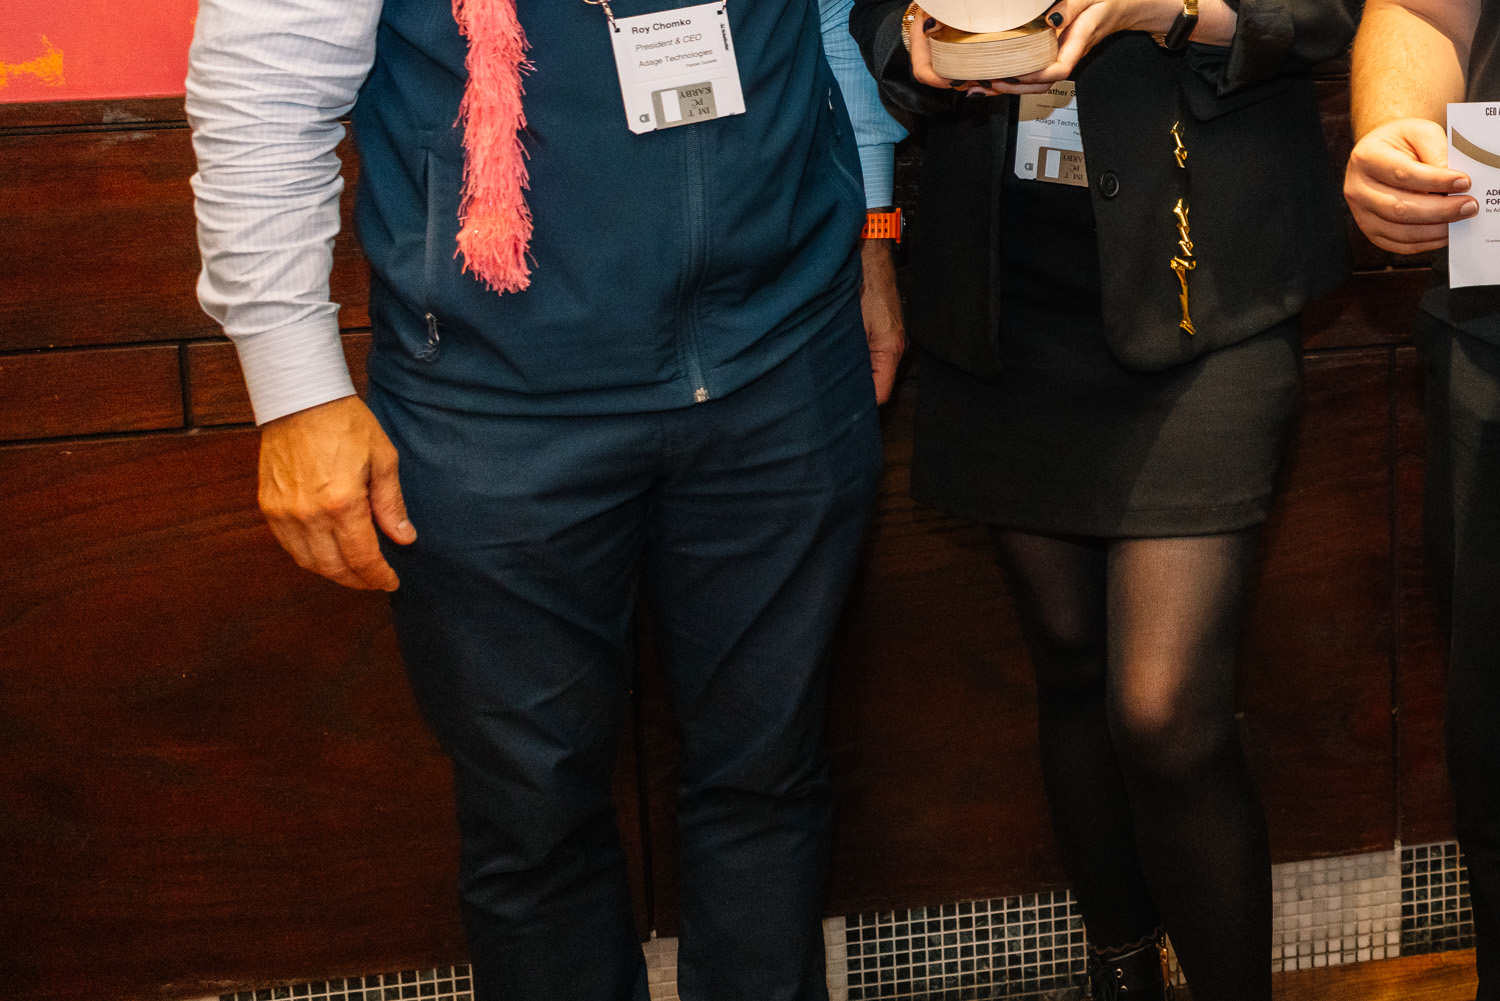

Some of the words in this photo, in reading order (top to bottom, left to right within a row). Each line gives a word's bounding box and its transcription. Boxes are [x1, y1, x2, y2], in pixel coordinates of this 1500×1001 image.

[631, 25, 650, 35] Roy
[652, 18, 692, 31] Chomko
[636, 39, 673, 51] President
[683, 33, 702, 43] CEO
[638, 58, 663, 68] Adage
[665, 49, 713, 63] Technologies
[1047, 87, 1068, 96] ather
[1485, 107, 1496, 116] CEO
[1035, 117, 1056, 125] Adage
